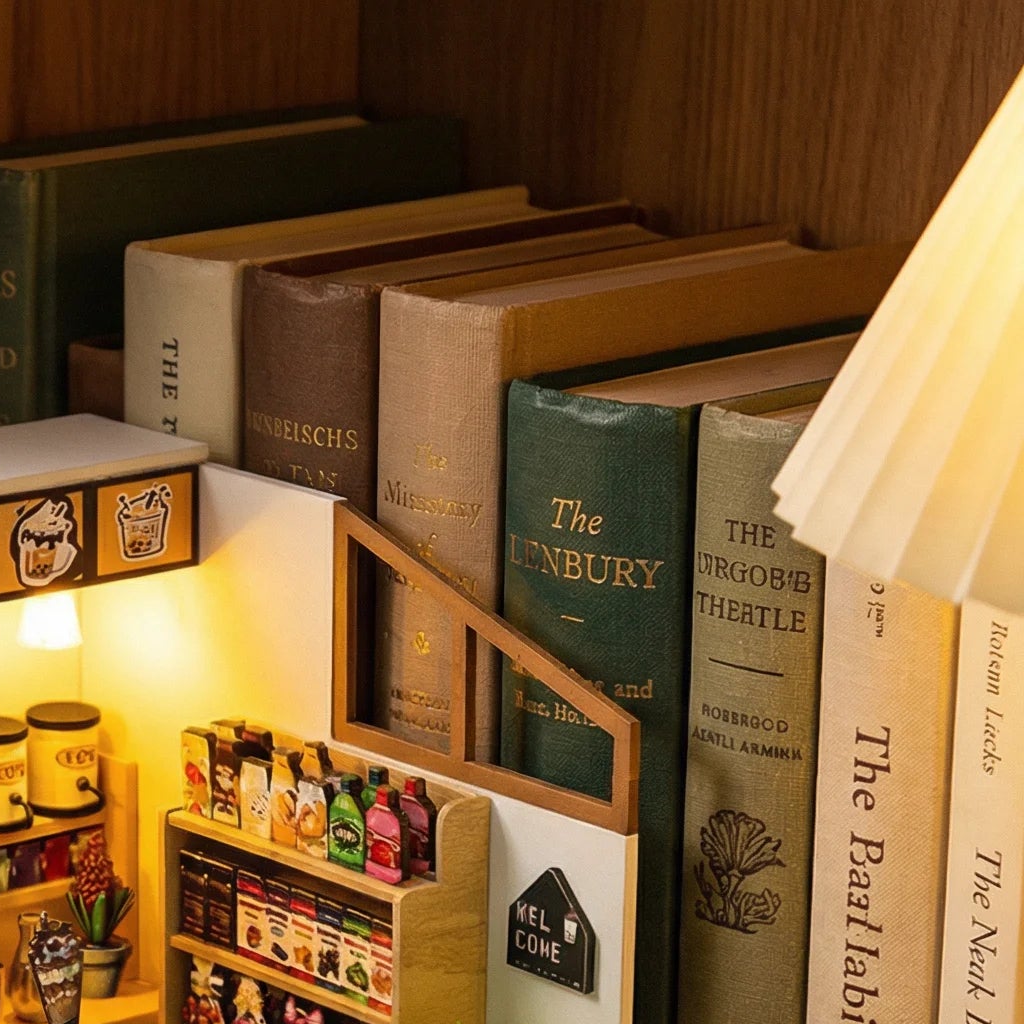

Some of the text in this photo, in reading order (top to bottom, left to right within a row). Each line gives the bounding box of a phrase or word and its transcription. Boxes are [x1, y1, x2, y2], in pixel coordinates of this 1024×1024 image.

[162, 338, 179, 400] THE
[550, 496, 604, 535] The
[725, 518, 777, 550] THE
[613, 679, 654, 700] and
[852, 725, 892, 811] The
[971, 848, 1003, 911] The
